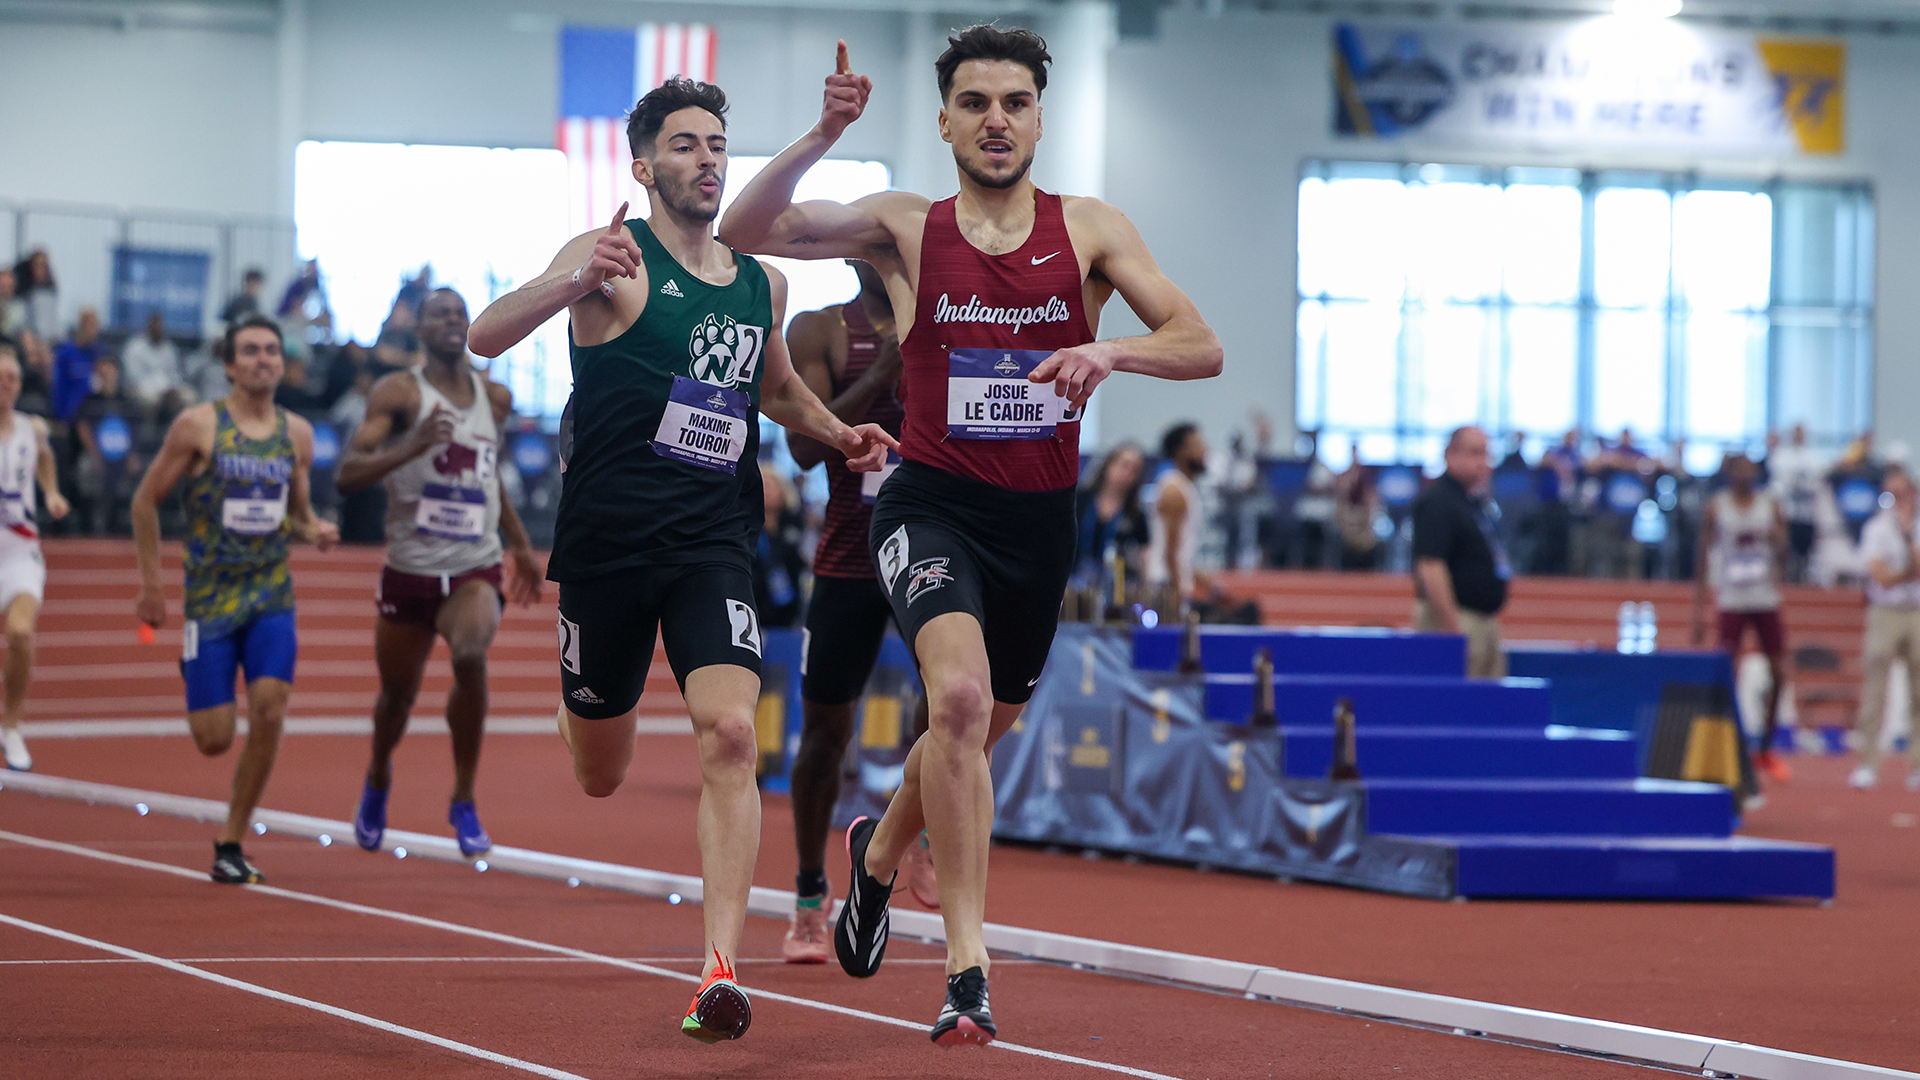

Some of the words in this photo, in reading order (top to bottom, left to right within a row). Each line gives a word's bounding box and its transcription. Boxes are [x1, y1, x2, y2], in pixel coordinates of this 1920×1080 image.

[660, 288, 685, 298] adidas
[933, 292, 1070, 335] Indianapolis
[699, 353, 733, 382] N
[738, 328, 757, 379] 2
[984, 384, 1029, 400] JOSUE
[687, 412, 732, 436] MAXIME
[965, 402, 984, 421] LE
[990, 402, 1045, 422] CADRE
[678, 427, 731, 456] TOURON
[883, 537, 901, 587] 3
[735, 604, 757, 651] 2
[561, 617, 573, 669] 2
[571, 691, 605, 704] adidas
